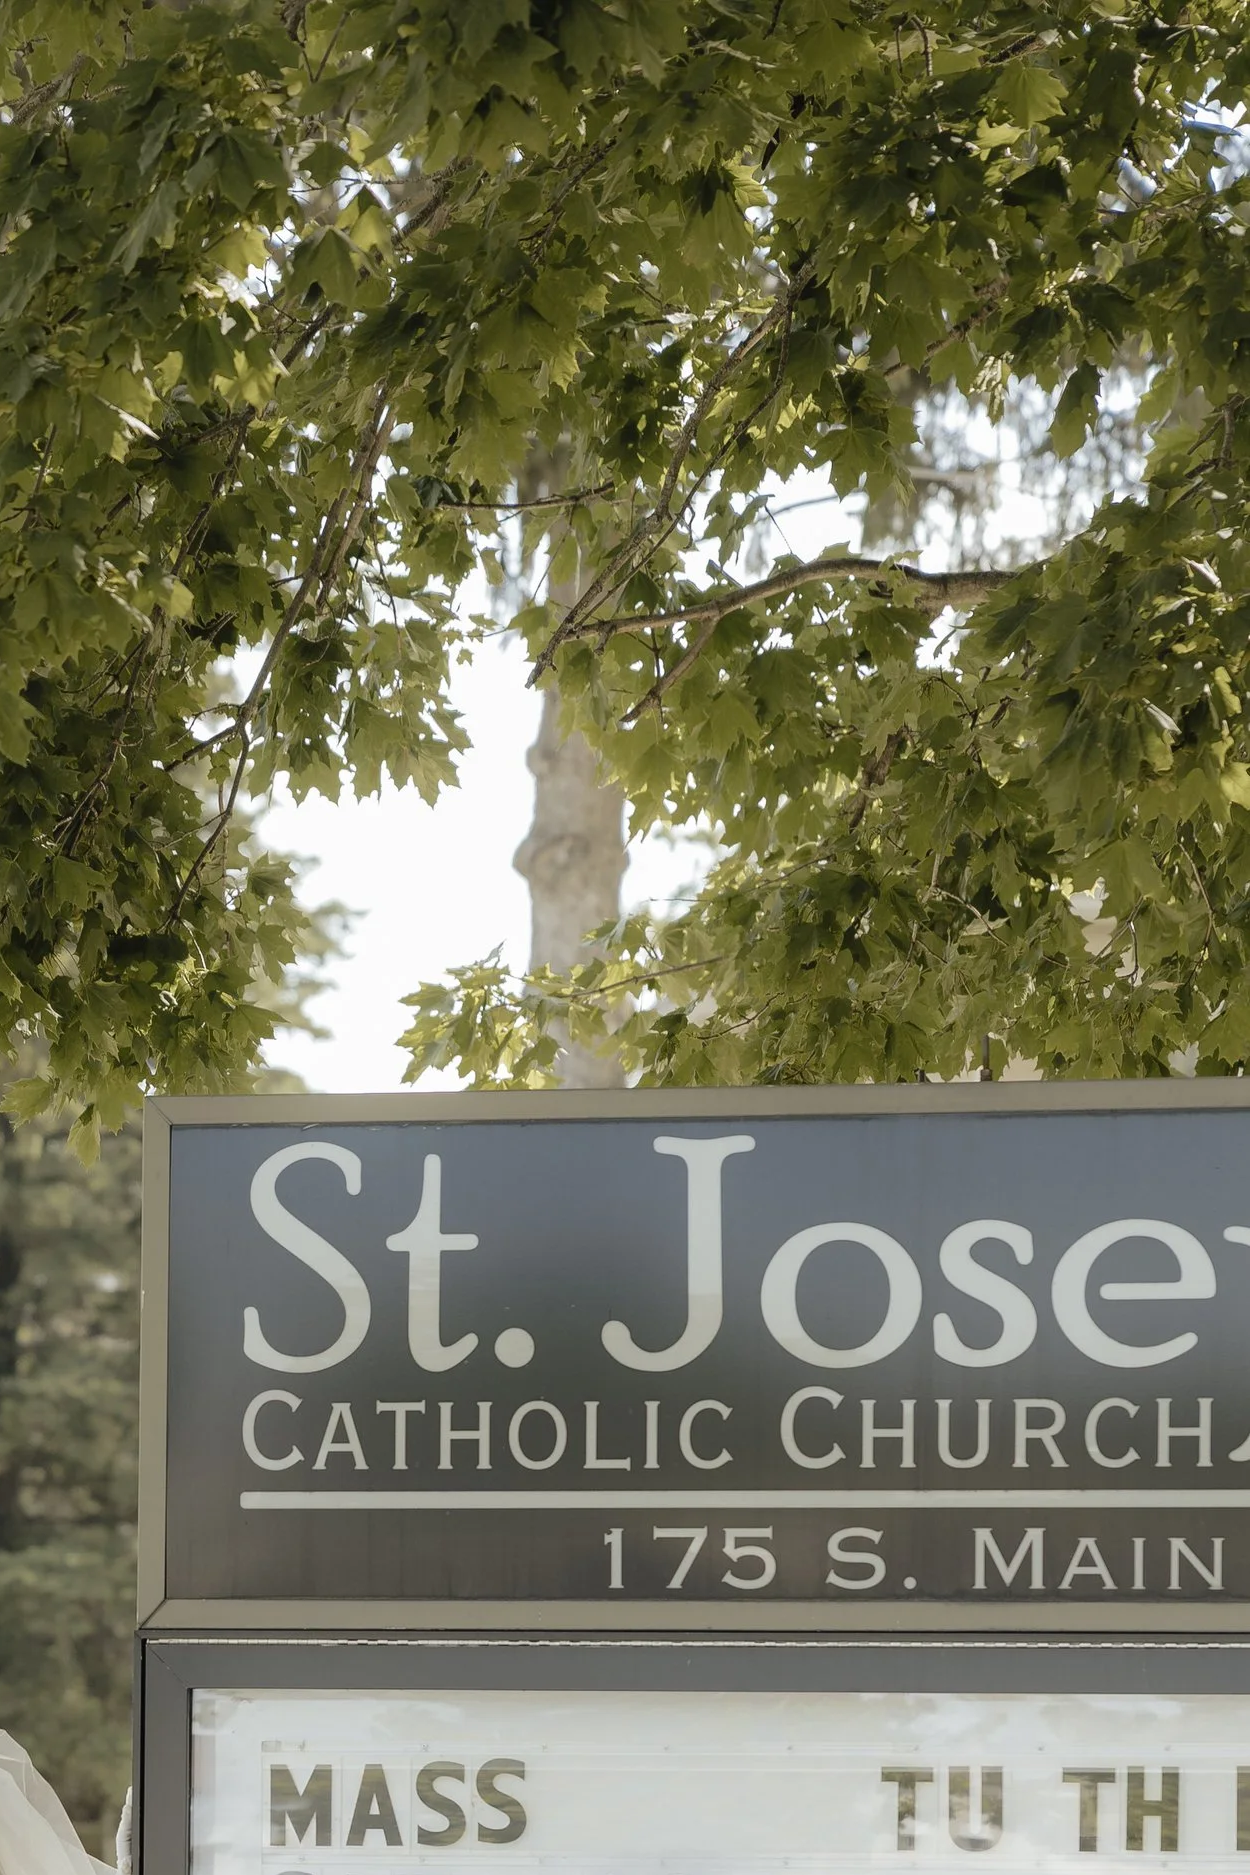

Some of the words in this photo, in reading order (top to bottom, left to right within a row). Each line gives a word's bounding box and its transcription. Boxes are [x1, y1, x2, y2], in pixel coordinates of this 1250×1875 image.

[243, 1141, 535, 1373] St.
[601, 1135, 1250, 1372] Jose
[242, 1389, 733, 1472] CATHOLIC
[780, 1385, 1214, 1470] CHURCH
[604, 1526, 777, 1590] 175
[826, 1526, 918, 1590] S.
[972, 1527, 1225, 1590] MAIN
[269, 1758, 528, 1847] MASS
[881, 1766, 1004, 1853] TU
[1062, 1765, 1180, 1852] TH
